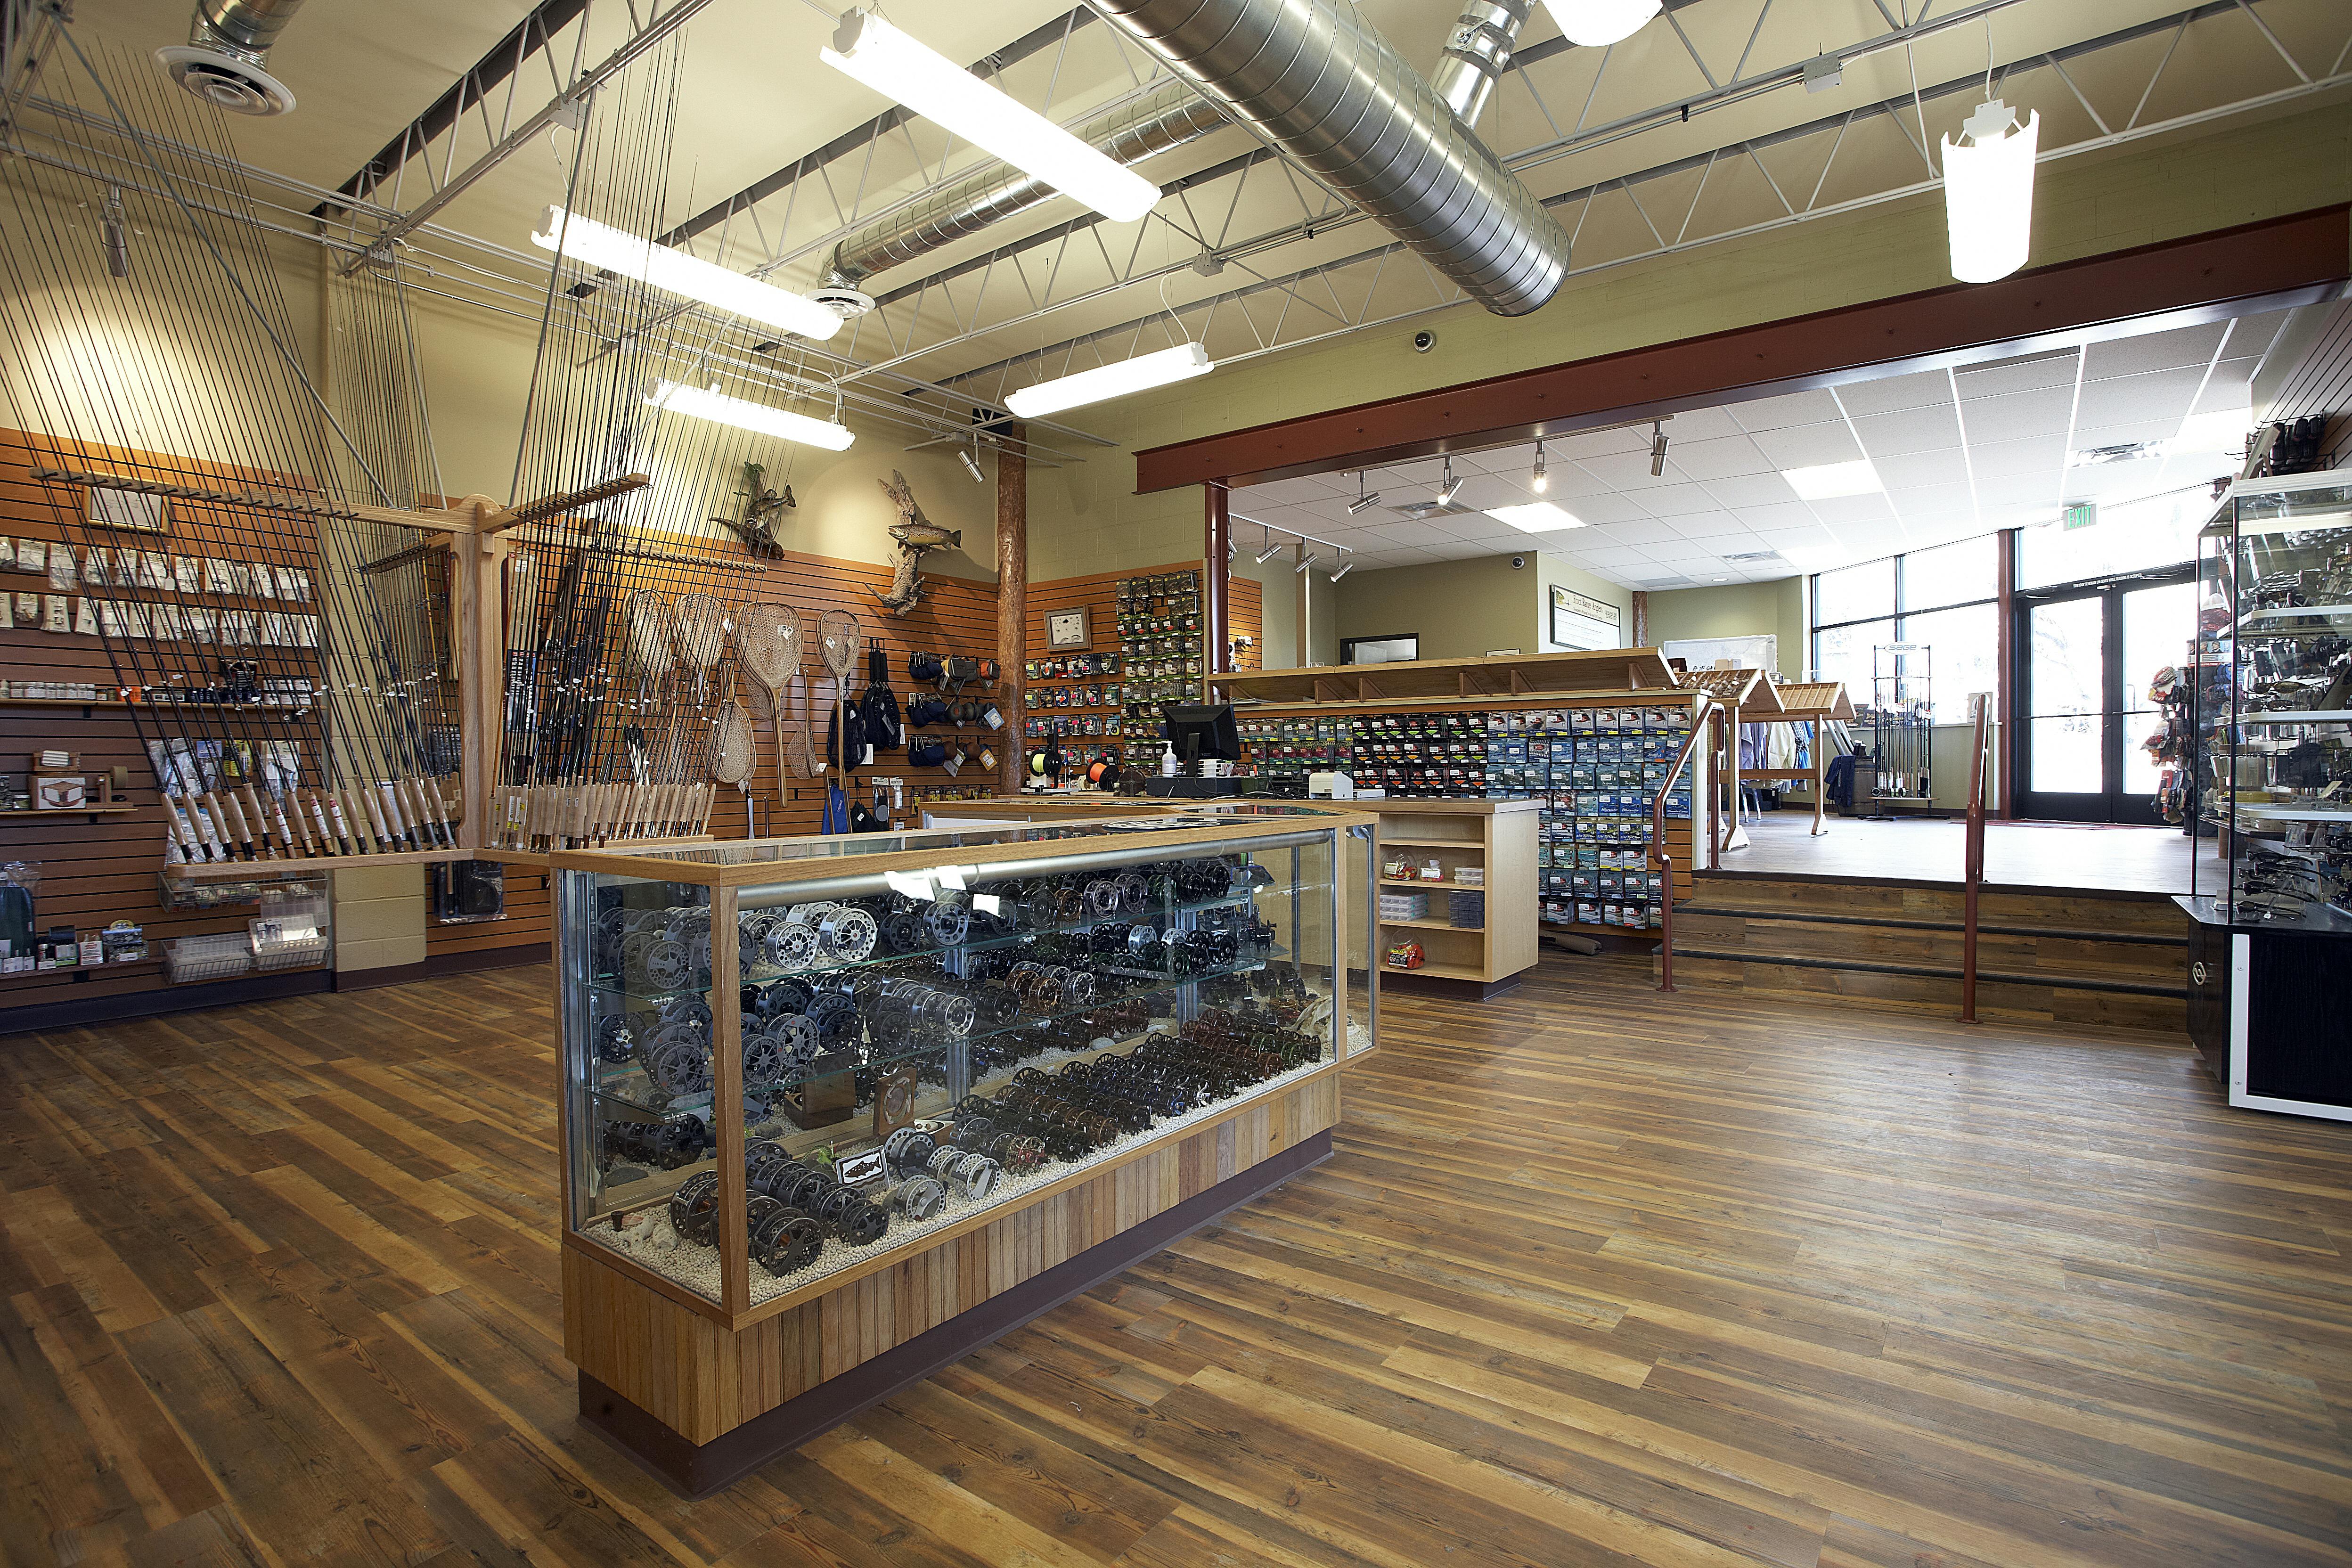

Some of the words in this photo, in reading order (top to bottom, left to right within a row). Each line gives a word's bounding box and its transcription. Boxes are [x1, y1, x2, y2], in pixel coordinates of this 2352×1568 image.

[2068, 505, 2091, 528] EXIT
[1582, 598, 1592, 610] Range
[1592, 602, 1603, 613] Anglers
[865, 1182, 886, 1194] RWORKS
